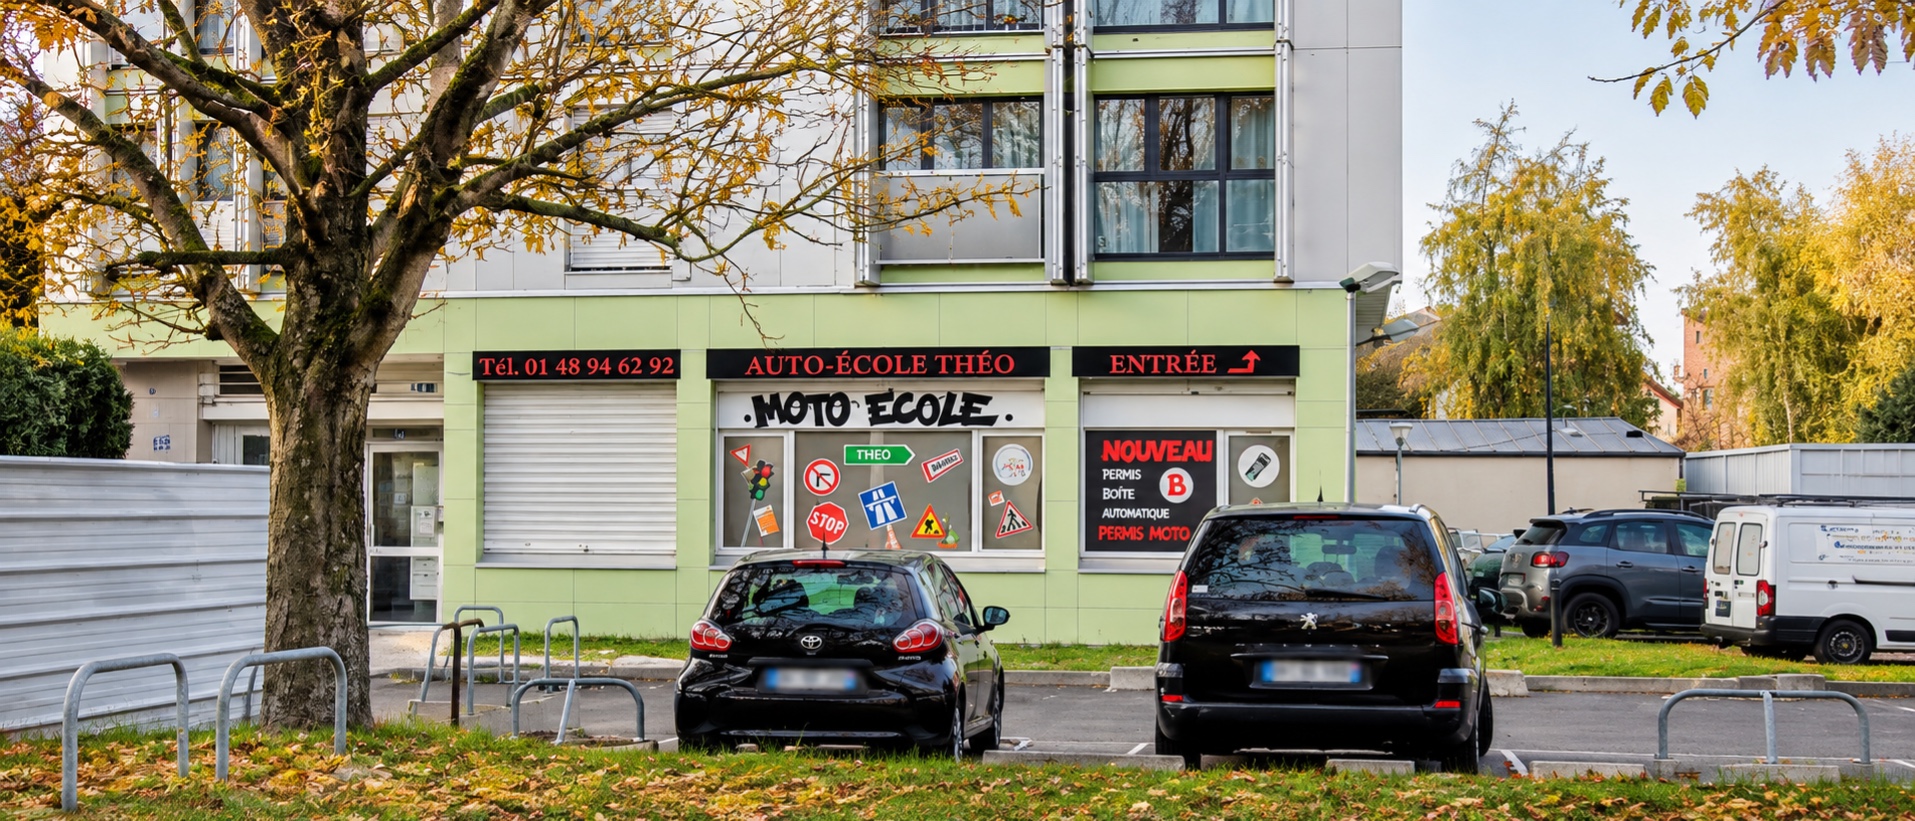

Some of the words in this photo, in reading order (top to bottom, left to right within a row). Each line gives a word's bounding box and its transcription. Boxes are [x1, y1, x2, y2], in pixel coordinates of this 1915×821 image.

[479, 358, 519, 376] Tél.
[524, 358, 548, 376] 01
[555, 358, 580, 375] 48
[587, 357, 612, 375] 94
[618, 357, 643, 375] 62
[649, 356, 674, 375] 92
[744, 350, 928, 375] AUTO-ÉCOLE
[934, 349, 1015, 375] THÉO
[1109, 350, 1217, 374] ENTRÉE
[856, 449, 891, 460] THEO
[1101, 439, 1213, 463] NOUVEAU
[1102, 468, 1142, 480] PERMIS
[1167, 473, 1187, 496] B
[810, 511, 845, 534] STOP
[1102, 508, 1170, 521] AUTOMATIQUE
[1098, 526, 1145, 541] PERMIS
[1148, 526, 1191, 541] MOTO
